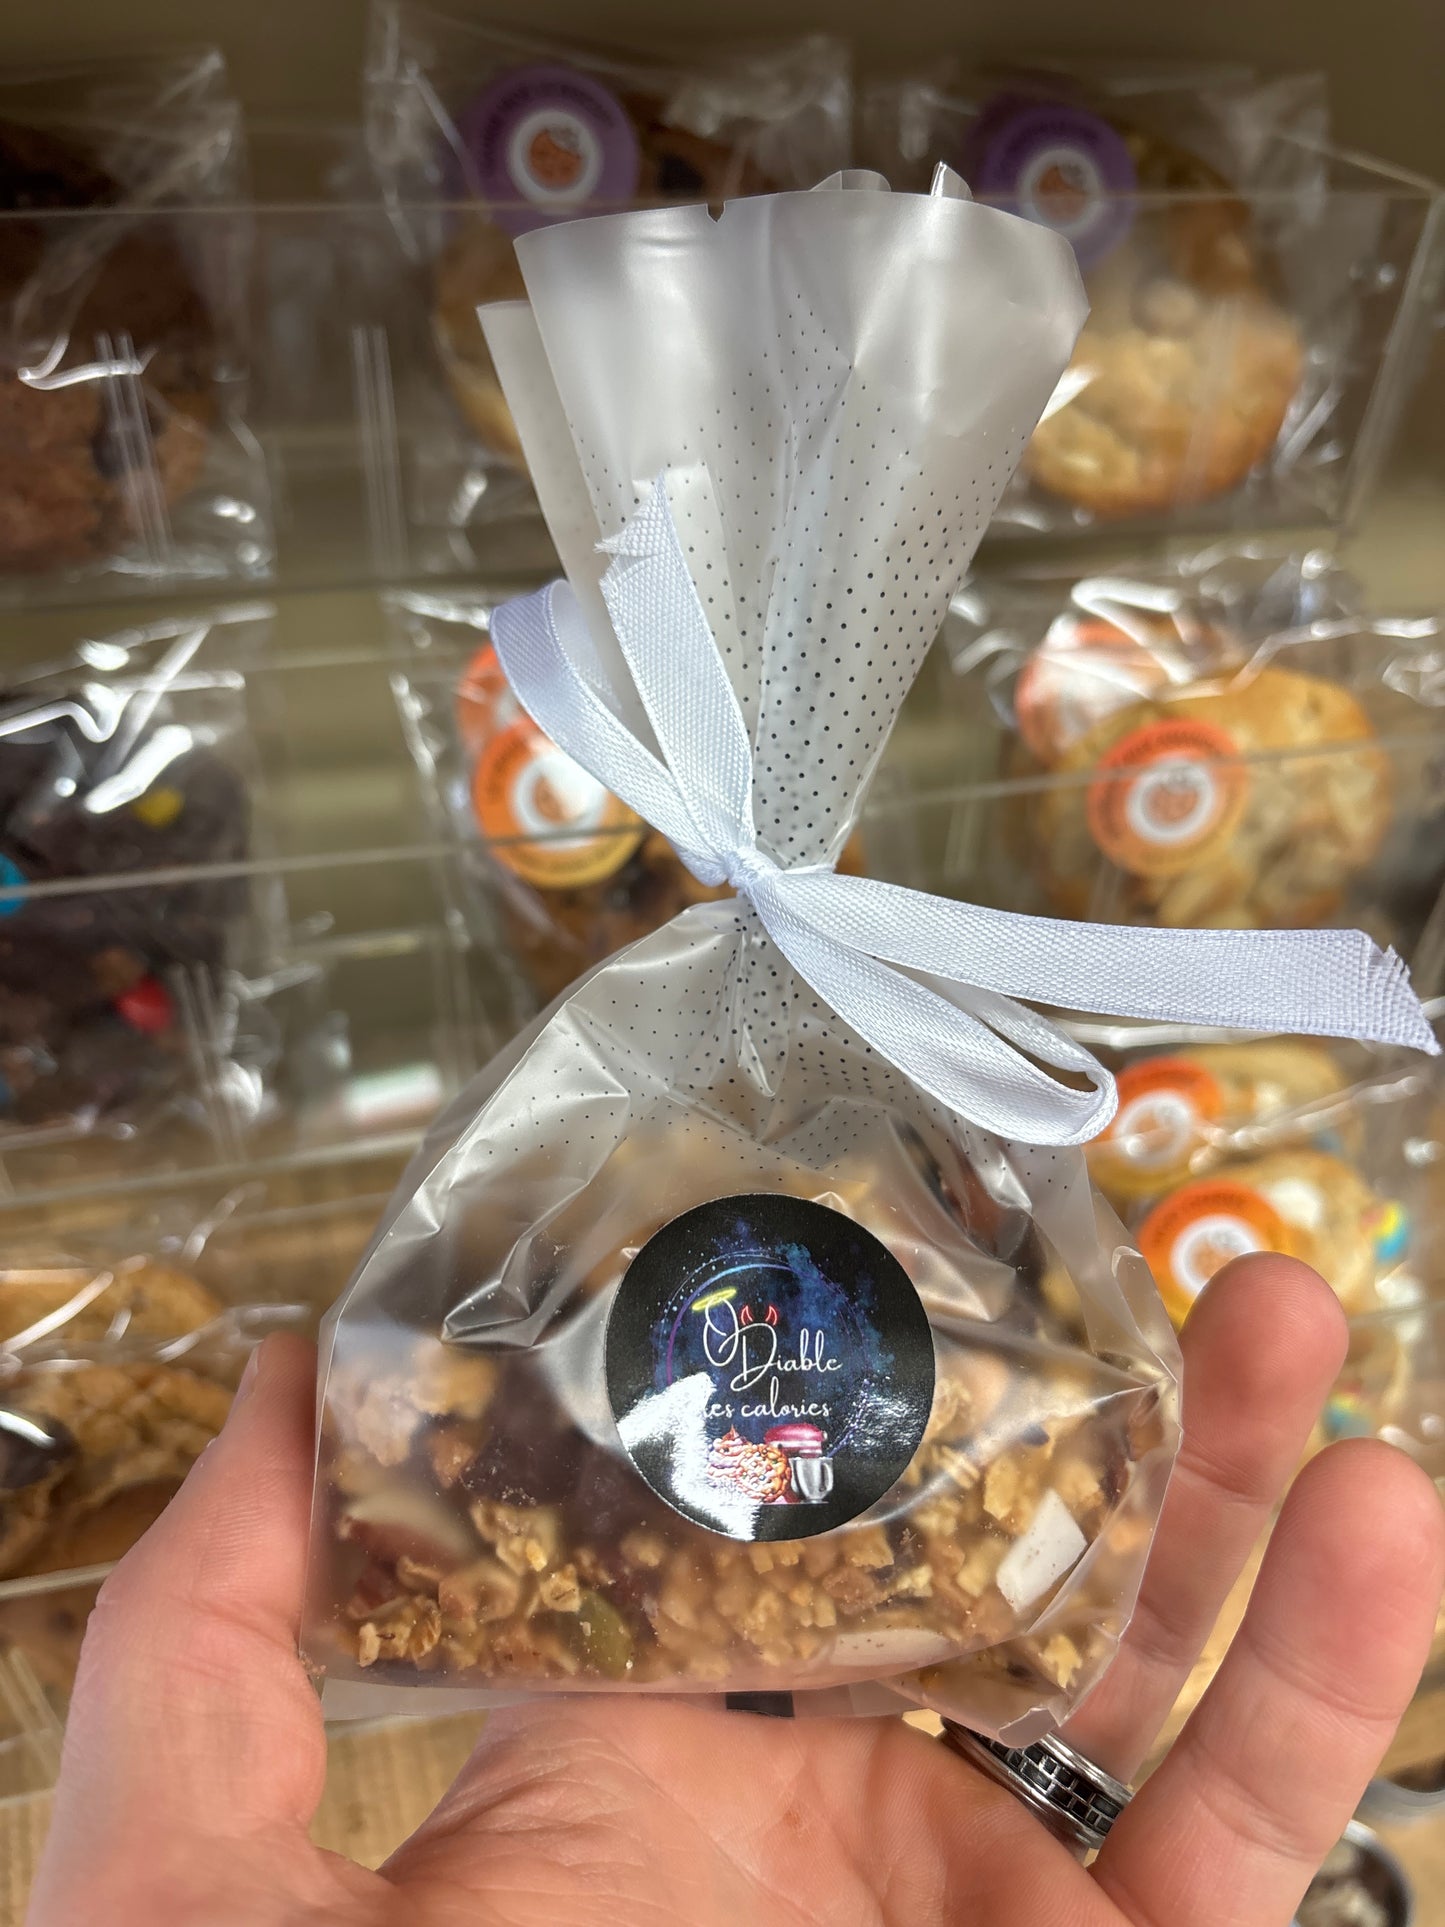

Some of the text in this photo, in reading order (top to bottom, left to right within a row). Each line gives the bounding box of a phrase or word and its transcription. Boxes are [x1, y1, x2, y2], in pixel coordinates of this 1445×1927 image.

[718, 1323, 843, 1391] Diable
[704, 1376, 832, 1418] es calories
